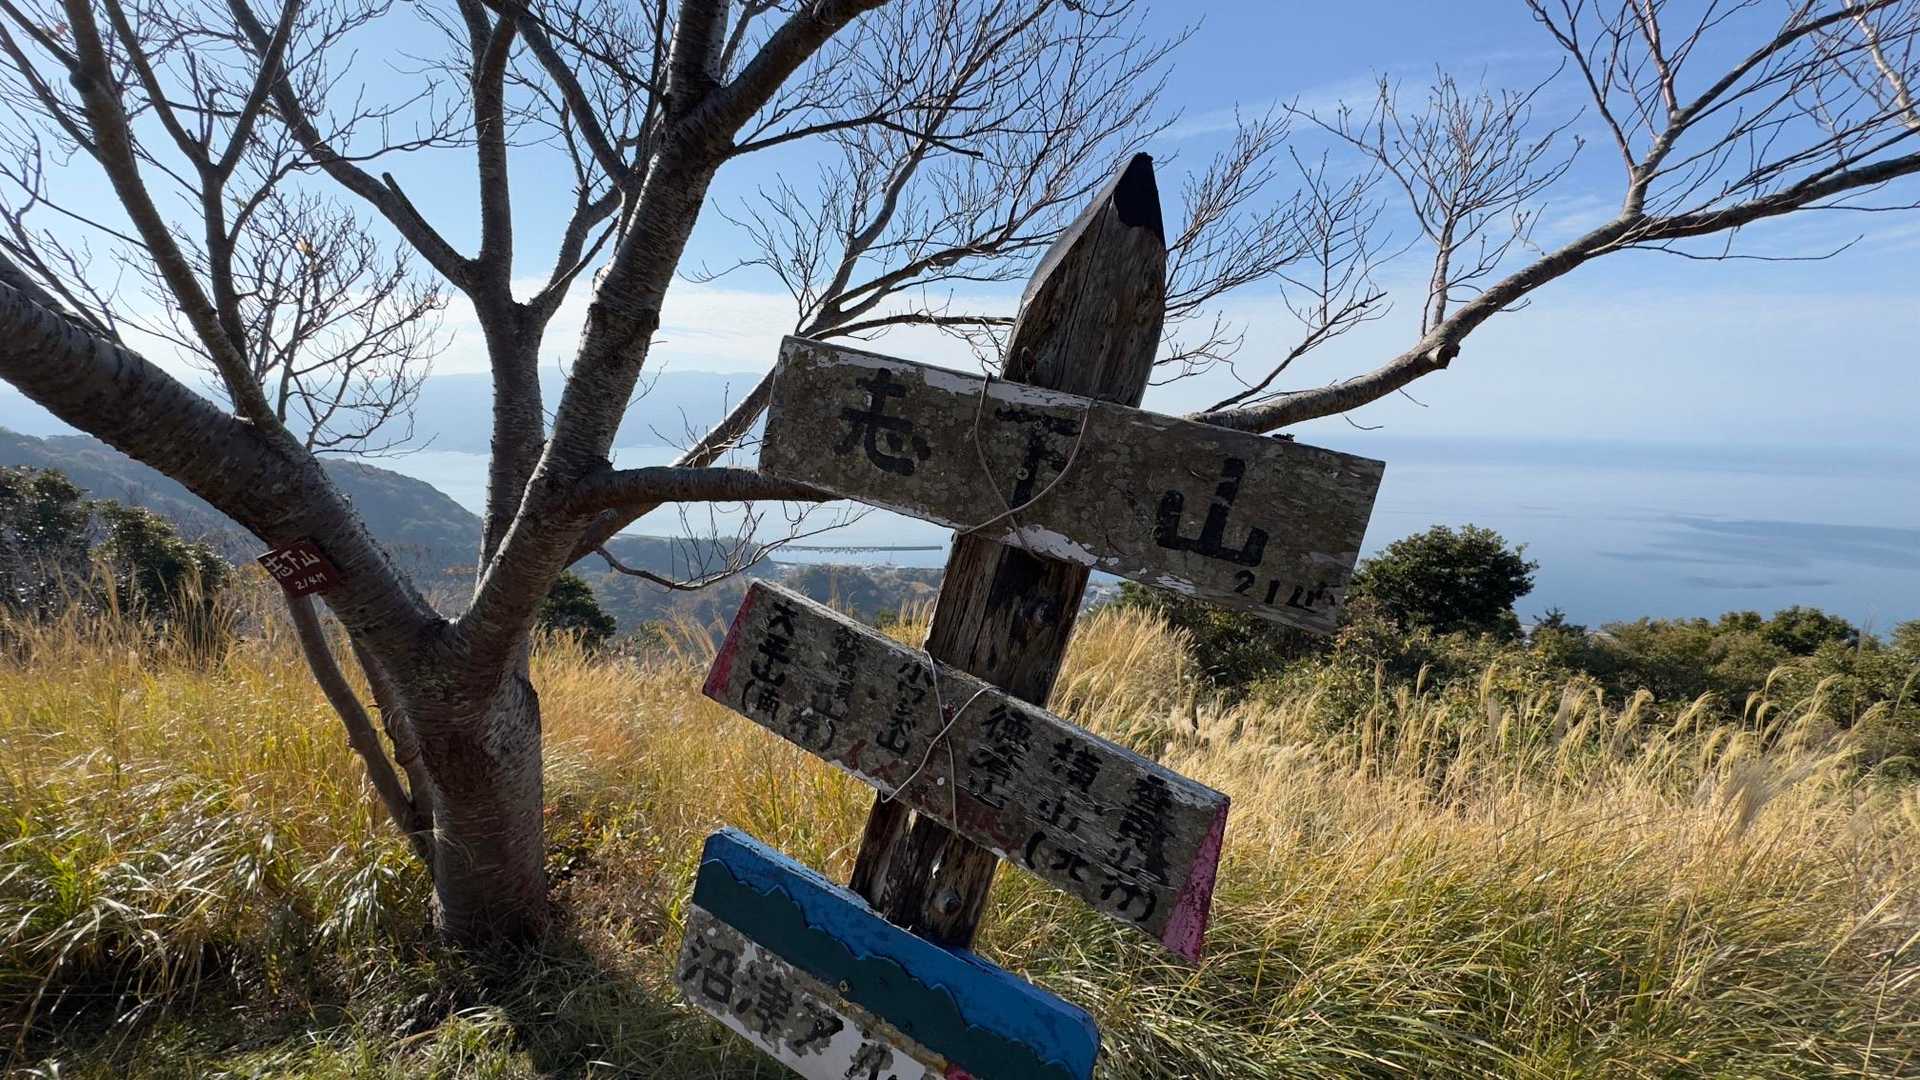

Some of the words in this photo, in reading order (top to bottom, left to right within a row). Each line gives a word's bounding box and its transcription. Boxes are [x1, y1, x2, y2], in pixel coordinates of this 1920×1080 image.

[835, 367, 1269, 567] 志下山
[265, 549, 321, 579] 志下山
[752, 600, 799, 687] 大平山
